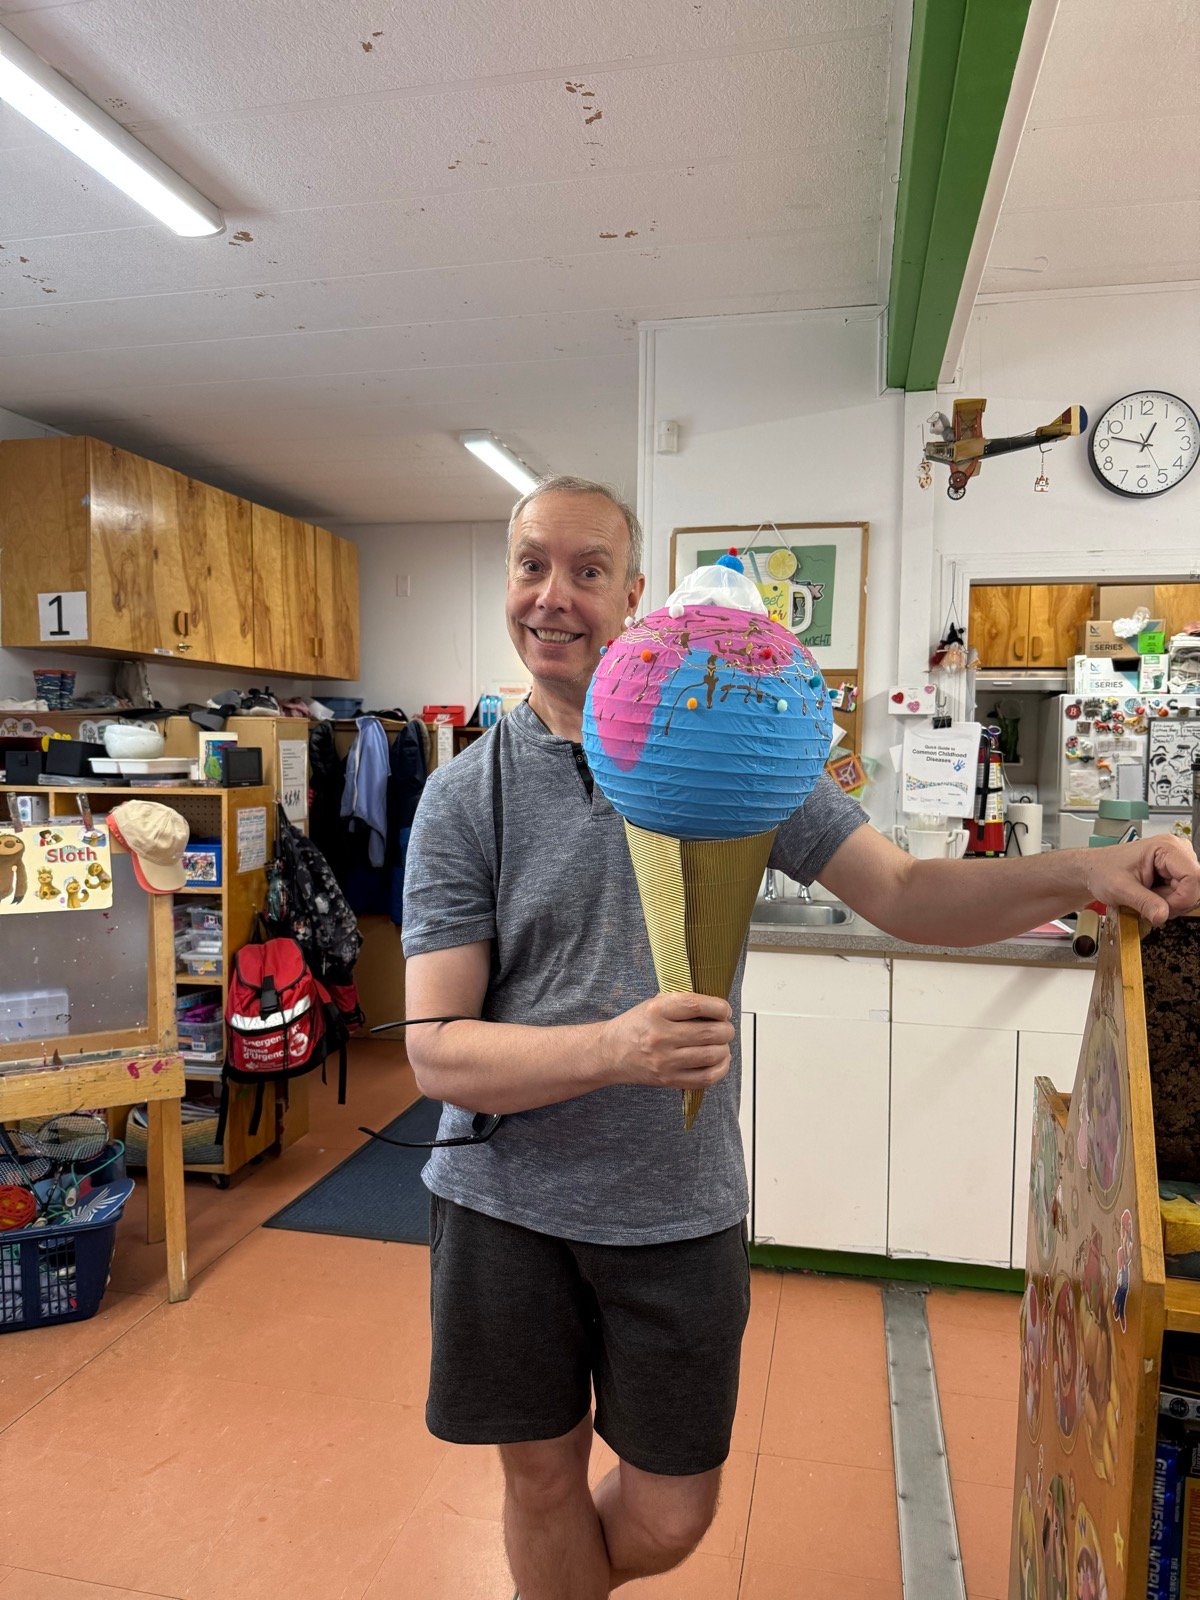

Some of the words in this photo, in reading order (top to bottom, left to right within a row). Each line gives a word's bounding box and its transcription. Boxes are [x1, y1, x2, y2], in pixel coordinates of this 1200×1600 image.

[1123, 405, 1133, 420] 11
[1140, 400, 1154, 415] 12
[1165, 403, 1169, 419] 1
[1107, 420, 1123, 435] 10
[1174, 417, 1187, 432] 2
[1099, 438, 1110, 452] 9
[1180, 436, 1191, 451] 3
[1103, 456, 1113, 470] 8
[1172, 455, 1183, 469] 4
[1119, 469, 1128, 484] 7
[1137, 474, 1148, 488] 6
[1157, 469, 1168, 483] 5
[49, 595, 70, 636] 1
[1094, 643, 1124, 651] SERIES
[1094, 681, 1124, 689] SERIES
[912, 748, 938, 757] Common
[938, 750, 967, 759] Childhood
[926, 756, 951, 764] Diseases
[46, 846, 98, 863] Sloth
[243, 1050, 287, 1062] d'Urgenc
